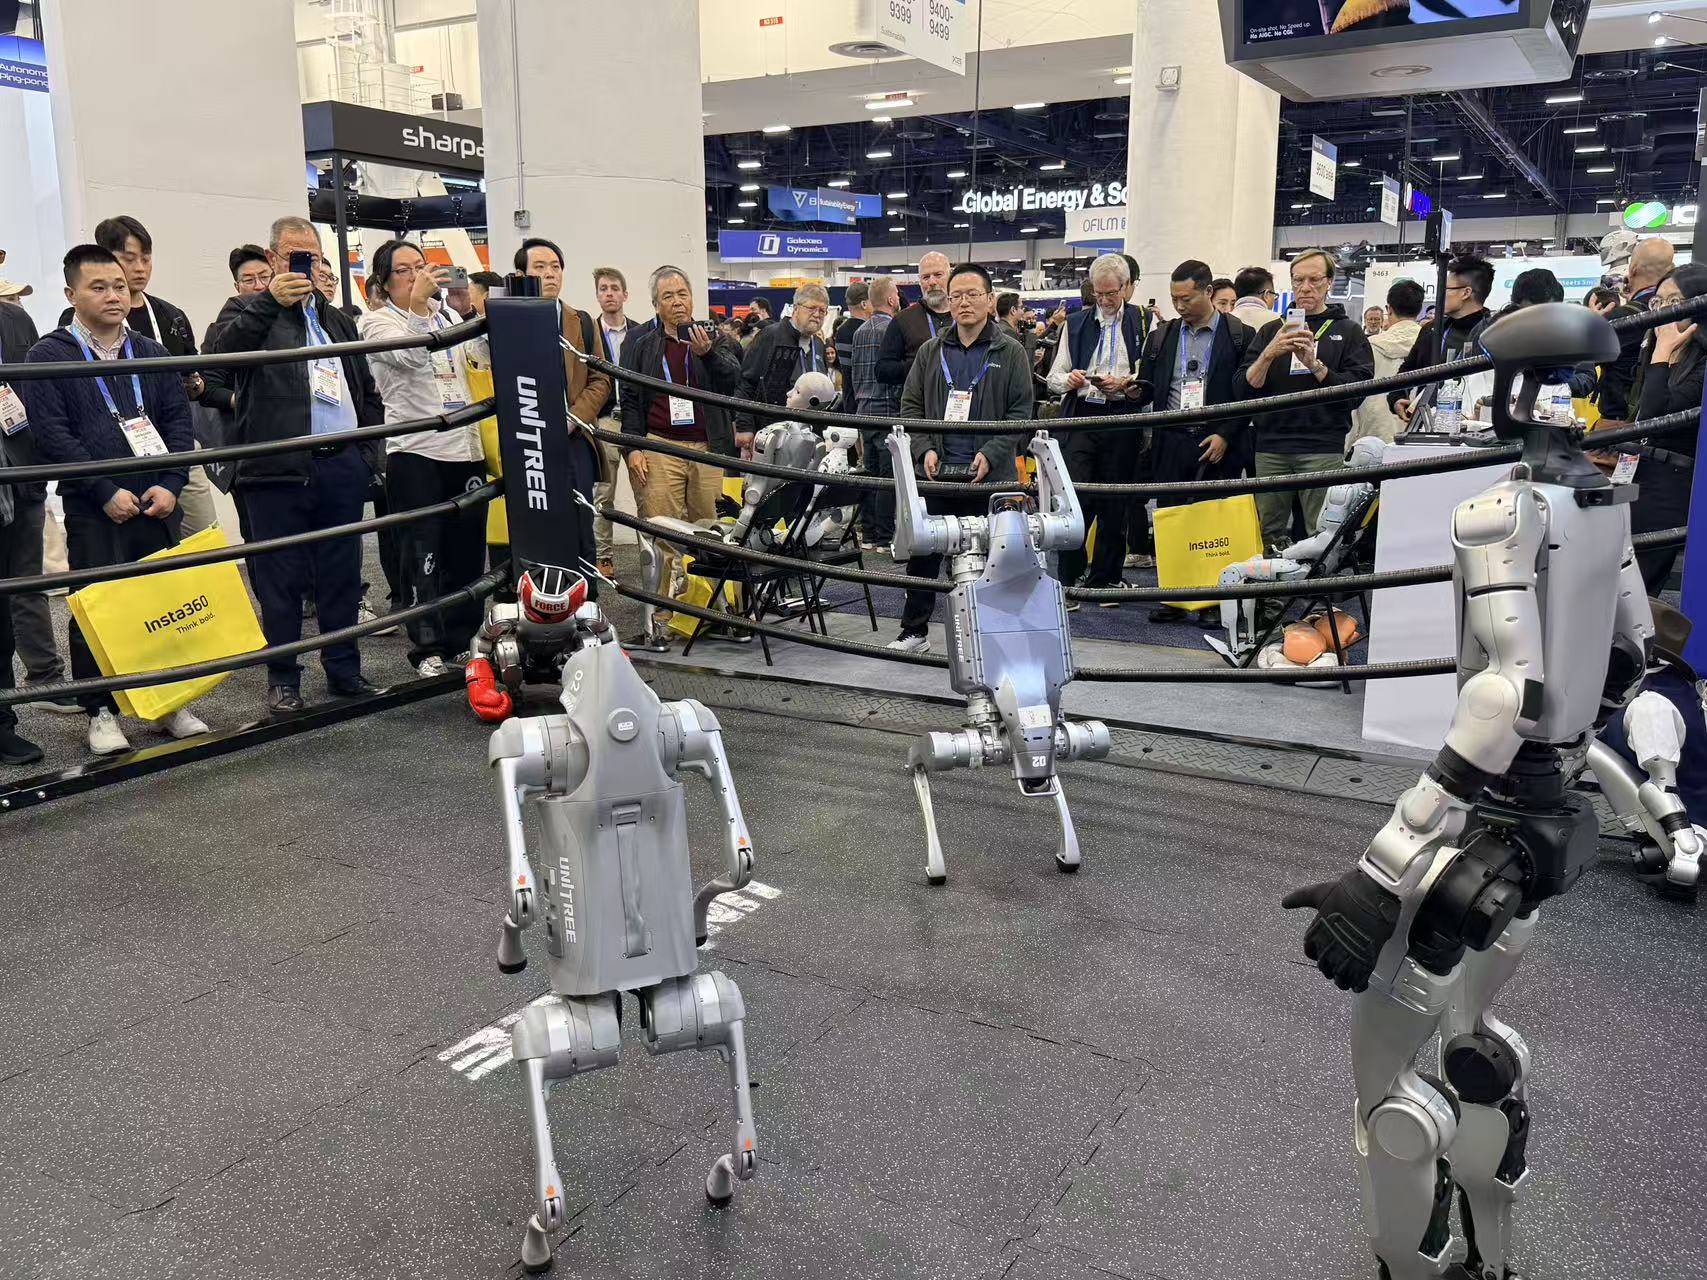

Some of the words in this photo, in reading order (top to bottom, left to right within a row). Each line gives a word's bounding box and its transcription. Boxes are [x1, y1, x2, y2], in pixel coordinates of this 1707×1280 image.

[889, 1, 911, 24] 9399
[929, 0, 954, 21] 9400-
[929, 18, 950, 41] 9499
[961, 187, 1019, 214] Global
[1022, 187, 1089, 213] Energy
[1089, 183, 1105, 206] &
[1082, 217, 1117, 233] OFILM
[787, 245, 829, 255] Dynamics
[515, 375, 548, 511] UNITREE
[1189, 536, 1230, 551] Insta360
[144, 594, 209, 634] Insta360
[534, 599, 567, 612] FORCE
[176, 621, 199, 634] Think
[198, 611, 216, 625] bold.
[954, 614, 965, 663] UNITREE
[559, 856, 577, 944] UNITREE
